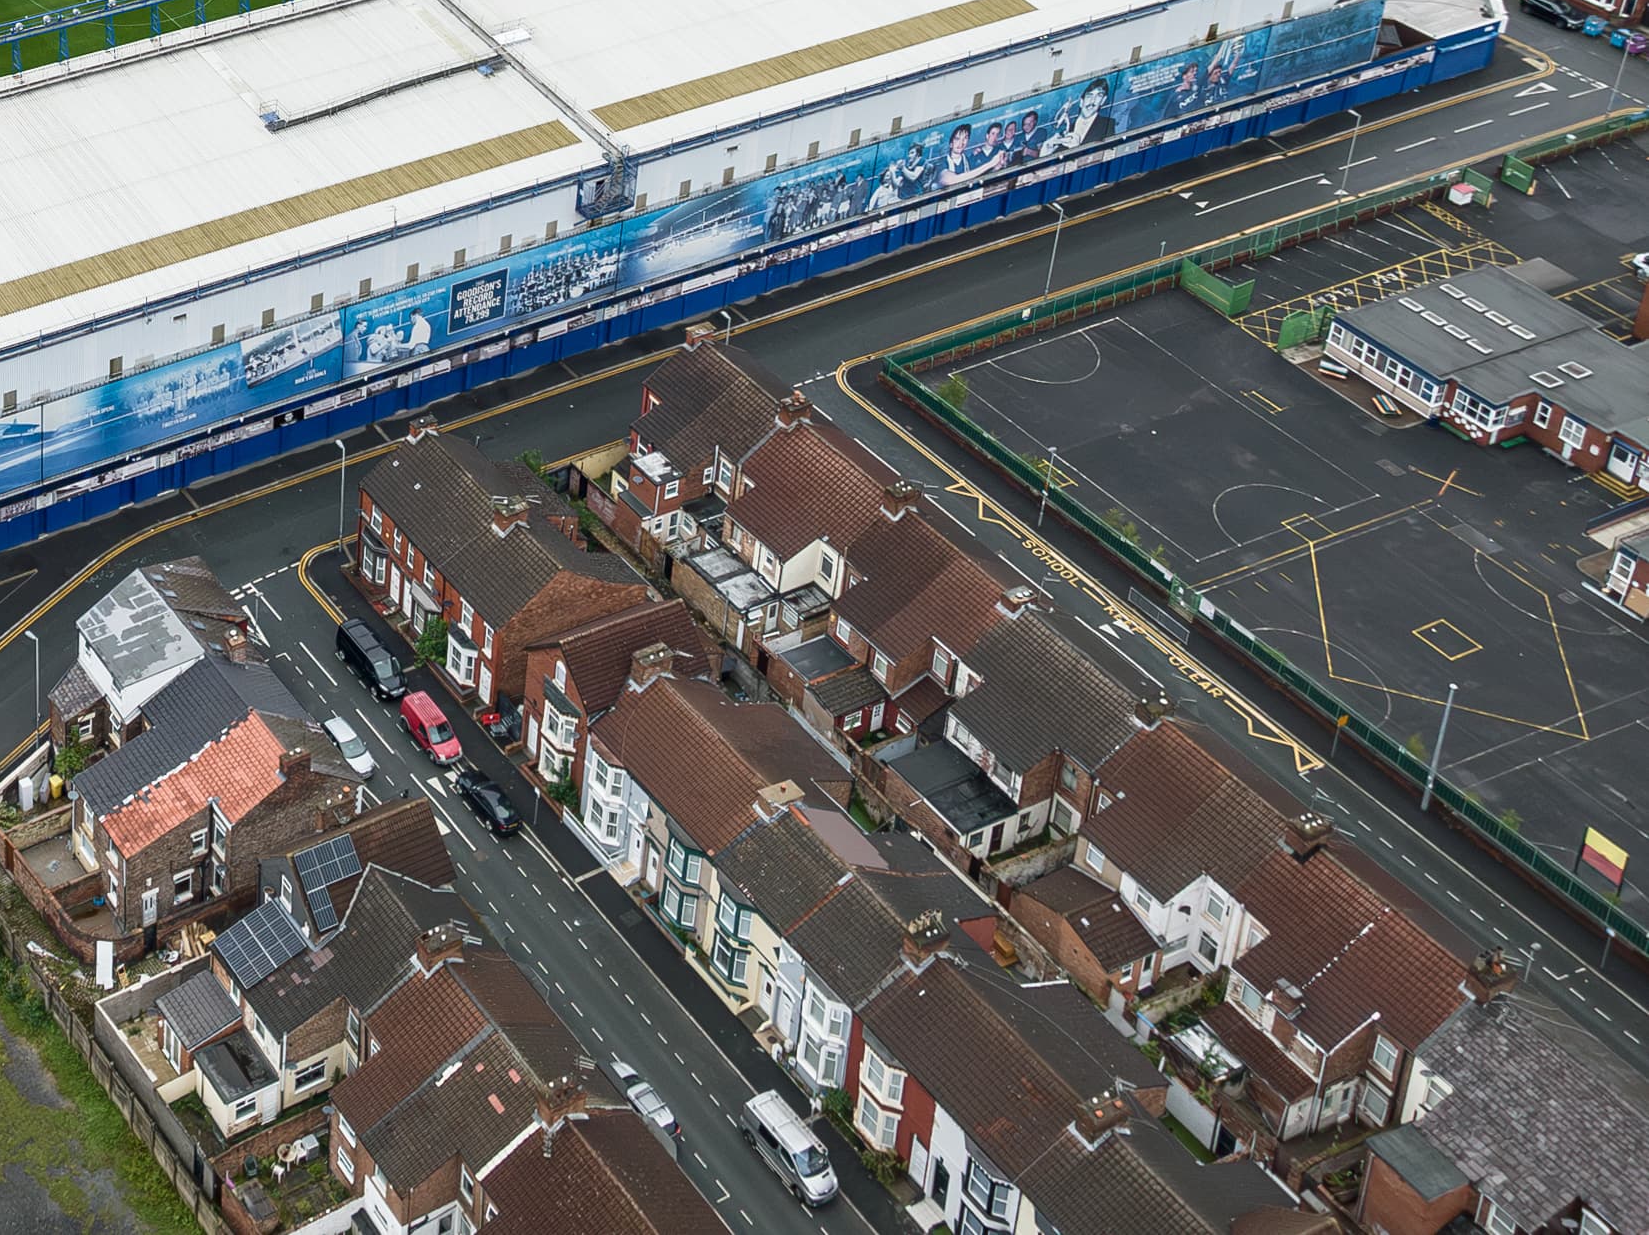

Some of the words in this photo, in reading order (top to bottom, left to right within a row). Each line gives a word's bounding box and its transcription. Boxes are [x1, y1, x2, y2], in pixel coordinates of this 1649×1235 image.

[456, 279, 502, 302] GOODISON'S
[463, 290, 494, 308] RECORD
[453, 296, 501, 320] ATTENDANCE
[1021, 539, 1081, 588] SCHOOL
[1103, 604, 1146, 635] KEEP
[1168, 655, 1226, 699] CLEAR
